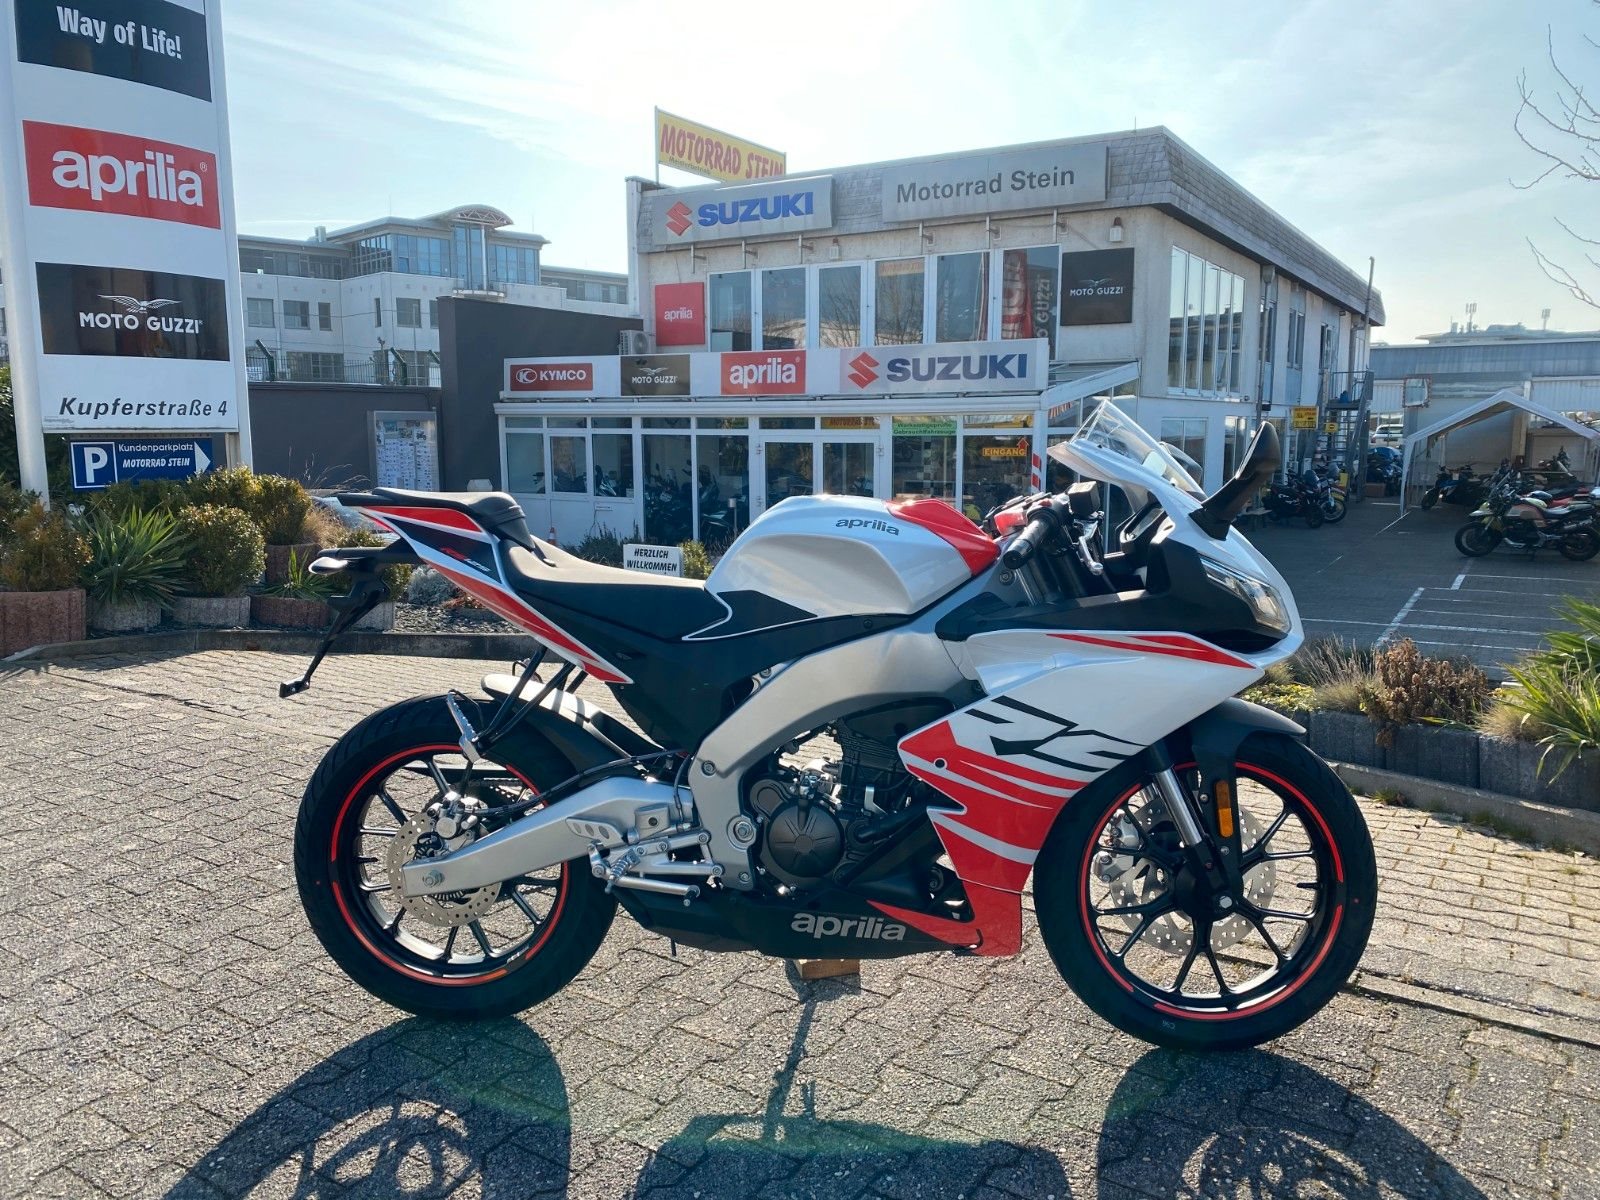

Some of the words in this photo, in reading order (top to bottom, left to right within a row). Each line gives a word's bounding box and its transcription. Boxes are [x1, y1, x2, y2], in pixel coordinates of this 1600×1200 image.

[56, 5, 106, 44] Way
[113, 21, 135, 46] of
[141, 24, 182, 59] Life!
[660, 123, 741, 176] MOTORRAD
[52, 149, 204, 207] aprilia
[896, 172, 1002, 203] Motorrad
[1010, 166, 1075, 192] Stein
[697, 191, 814, 227] SUZUKI
[1069, 288, 1094, 297] MOTO
[1096, 286, 1124, 295] GUZZI
[79, 311, 140, 330] MOTO
[146, 317, 200, 335] GUZZI
[664, 306, 693, 322] aprilia
[539, 369, 587, 381] KYMCO
[631, 376, 652, 384] MOTO
[654, 375, 678, 384] GUZZI
[729, 357, 796, 389] aprilia
[886, 353, 1028, 383] SUZUKI
[59, 397, 212, 420] Kupferstraße
[218, 400, 228, 417] 4
[119, 443, 194, 453] Kundenparkplatz
[983, 448, 1025, 457] EINGANG
[83, 446, 108, 483] P
[122, 458, 166, 468] MOTORRAD
[168, 457, 190, 467] STEIN
[835, 519, 900, 536] aprilia
[626, 559, 678, 571] WILLKOMMEN
[634, 548, 669, 559] HERZLICH
[790, 912, 907, 941] aprilia
